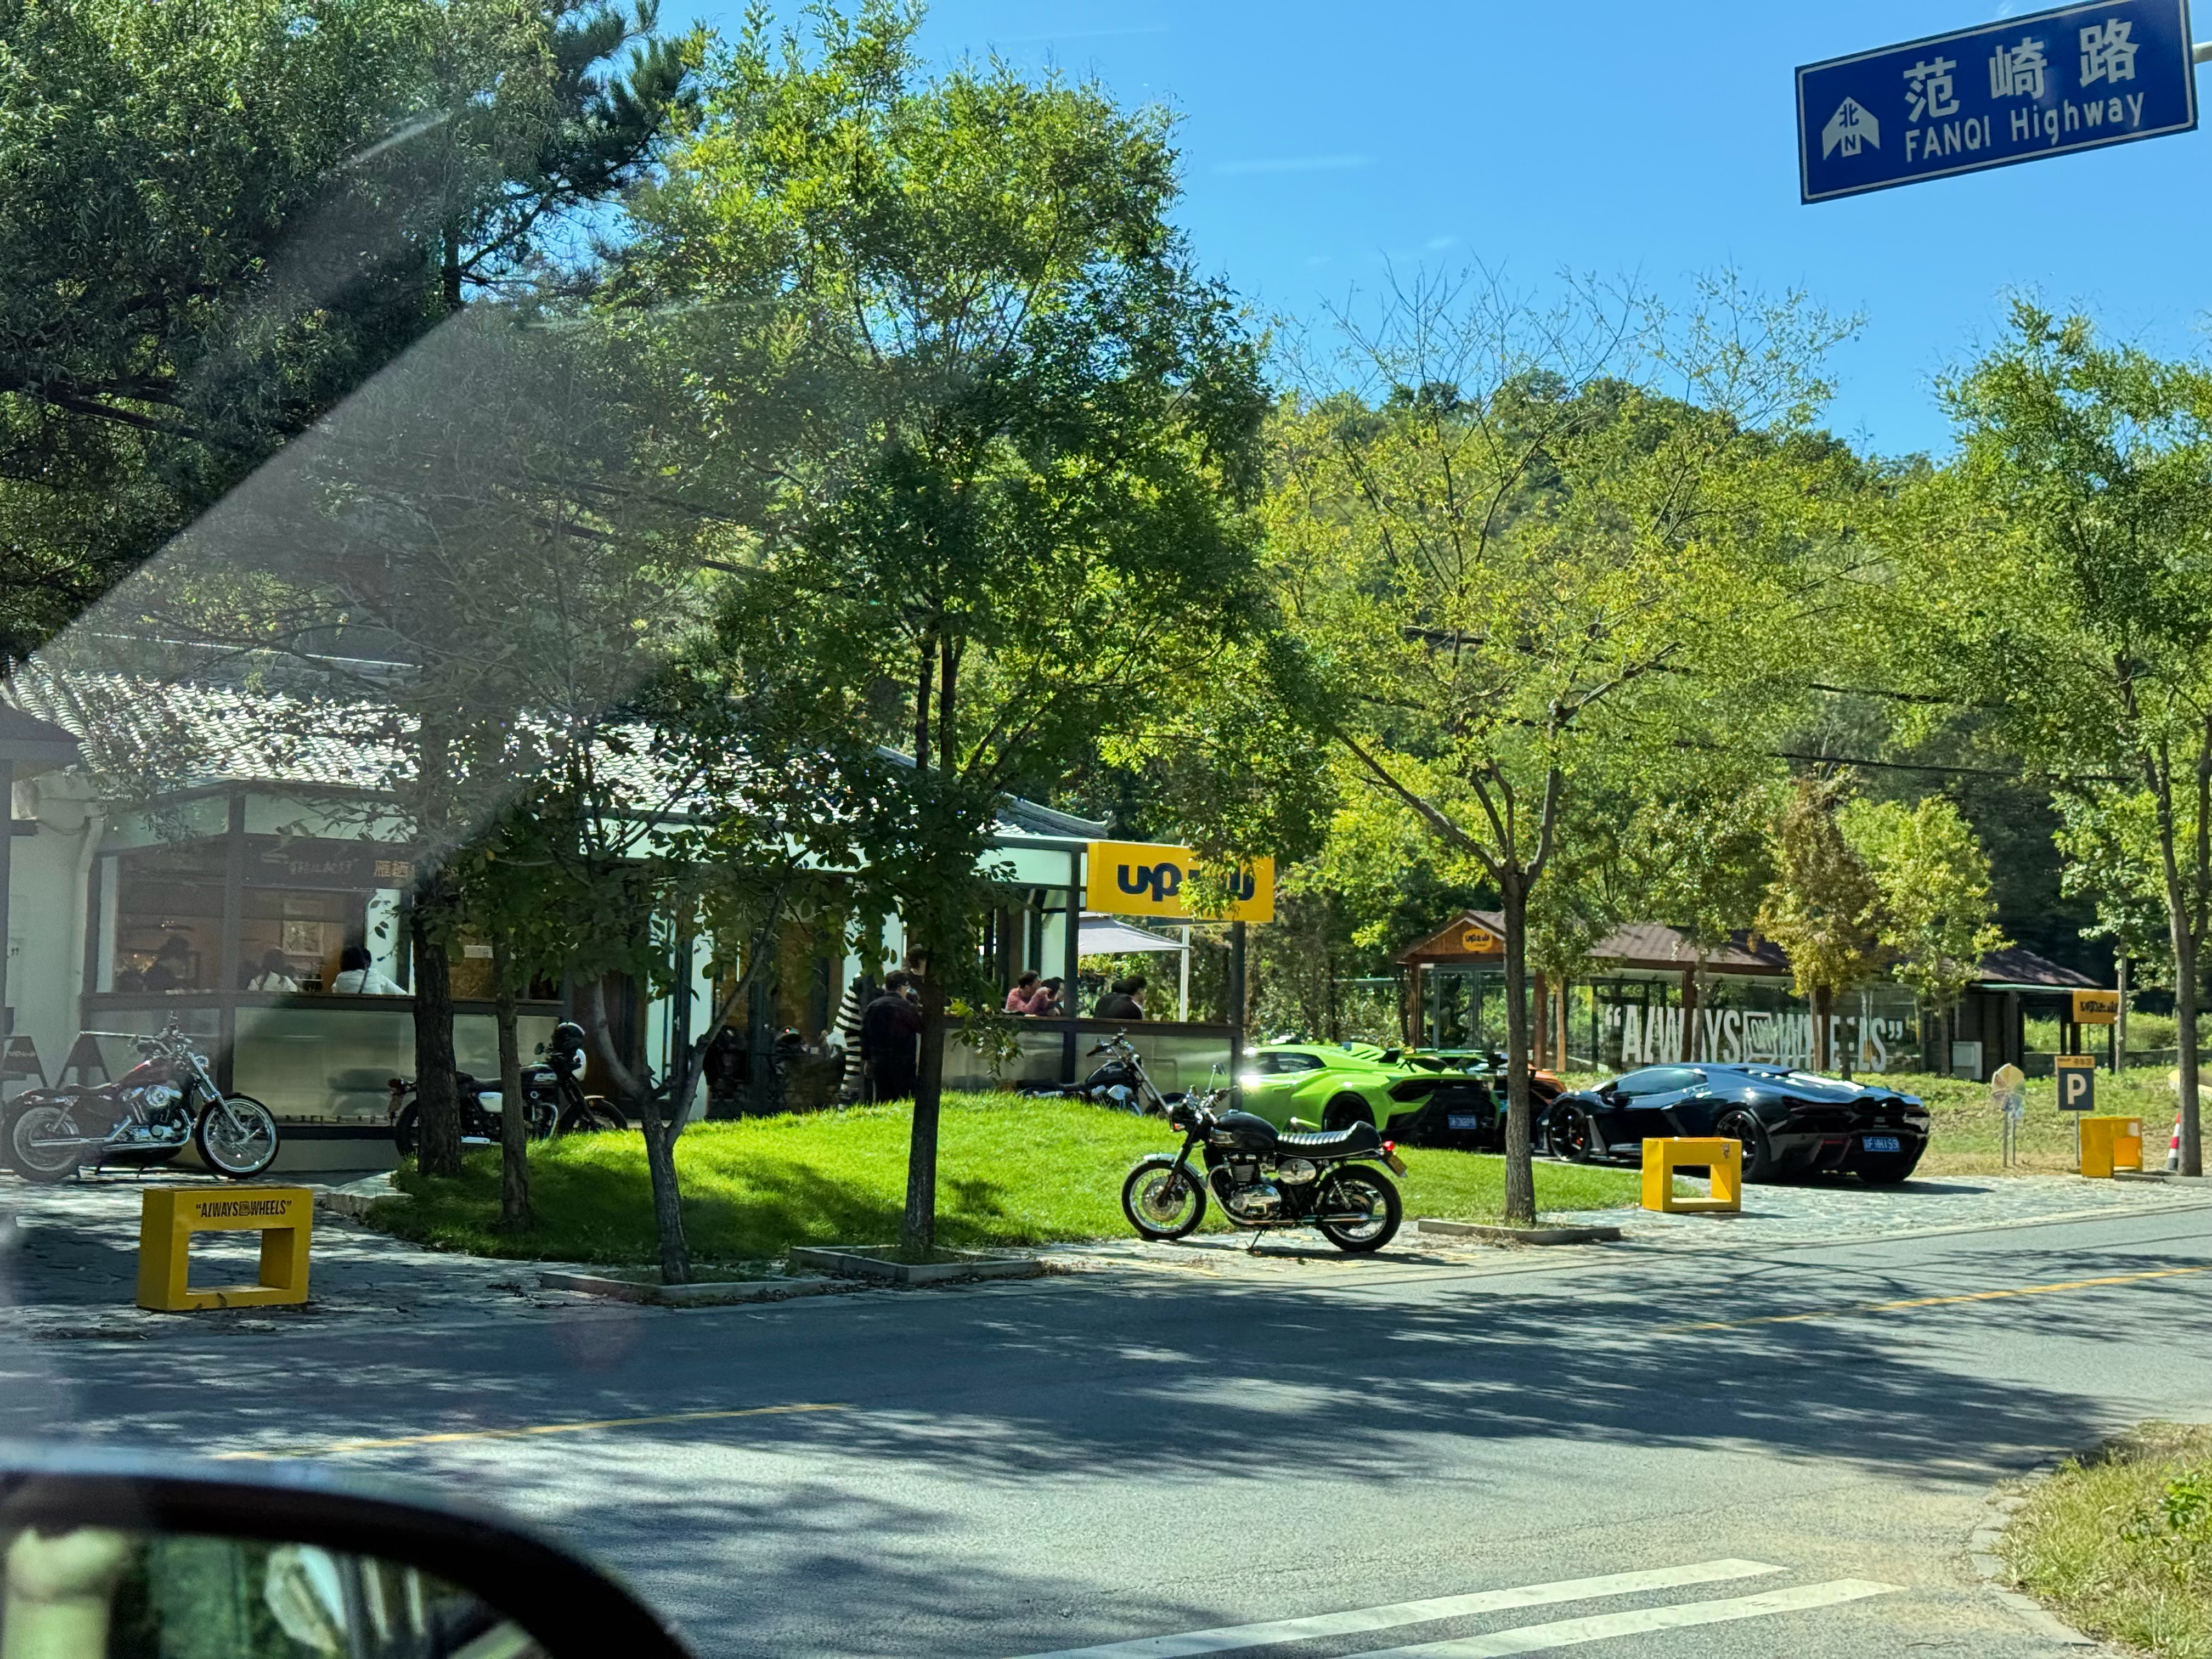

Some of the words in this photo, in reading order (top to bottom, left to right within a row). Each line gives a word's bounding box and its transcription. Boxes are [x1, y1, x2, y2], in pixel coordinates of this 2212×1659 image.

[1903, 18, 2140, 122] 范崎路
[1839, 103, 1859, 128] 北
[1905, 115, 1991, 162] FANQI
[2011, 92, 2144, 146] Highway
[1845, 134, 1855, 151] N
[2067, 1074, 2086, 1105] P
